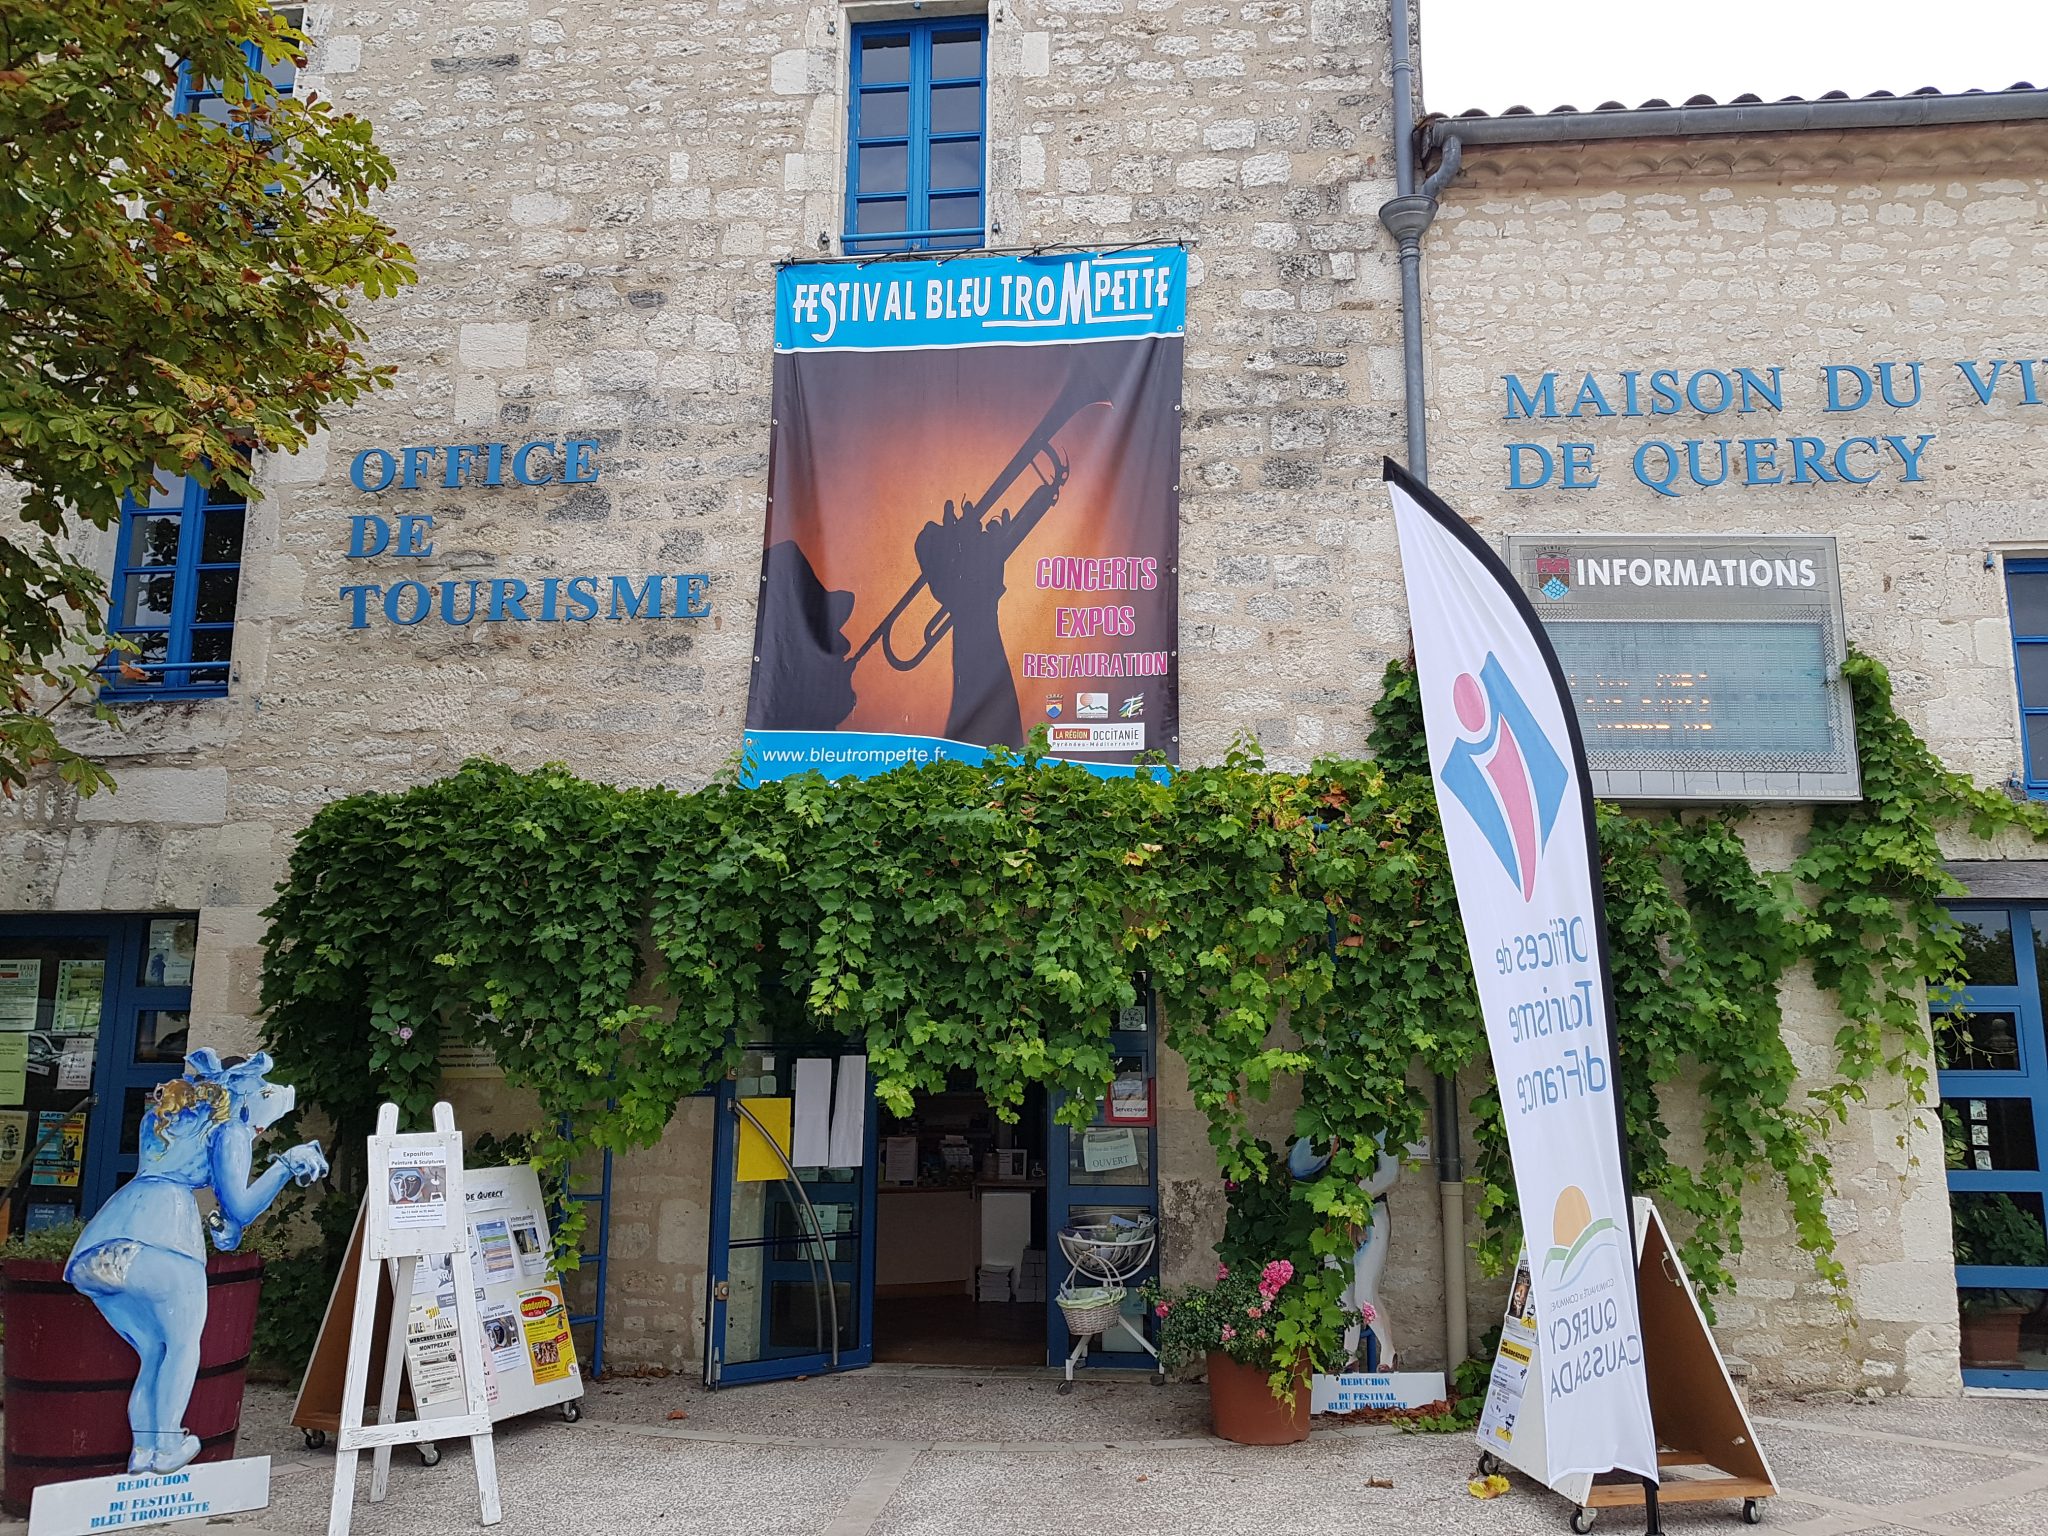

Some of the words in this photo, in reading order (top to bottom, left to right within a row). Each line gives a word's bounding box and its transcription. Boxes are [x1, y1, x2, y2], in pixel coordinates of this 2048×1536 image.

[793, 279, 917, 343] FESTIVAL
[926, 276, 992, 320] BLEU
[1502, 366, 1784, 419] MAISON
[1821, 361, 1923, 412] DU
[1955, 359, 2048, 406] VI
[349, 439, 601, 493] OFFICE
[1504, 442, 1600, 490] DE
[1632, 433, 1936, 497] QUERCY
[344, 514, 434, 559] DE
[1036, 556, 1157, 591] CONCERTS
[1576, 558, 1816, 588] INFORMATIONS
[339, 573, 712, 630] TOURISME
[1055, 605, 1135, 638] EXPOS
[1022, 651, 1168, 678] RESTAURATION
[762, 746, 947, 765] www.bleutrompette.fr
[1092, 1155, 1129, 1168] OUVERT
[477, 1190, 504, 1199] QUERCY
[1340, 1377, 1390, 1386] REDUCHON
[1328, 1402, 1350, 1410] BLEU
[1338, 1393, 1351, 1401] DU
[1353, 1393, 1396, 1401] FESTIVAL
[116, 1472, 190, 1492] REDUCHON
[90, 1514, 126, 1529] BLEU
[129, 1501, 210, 1523] TROMPETTE
[109, 1500, 127, 1513] DU
[131, 1492, 195, 1510] FESTIVAL
